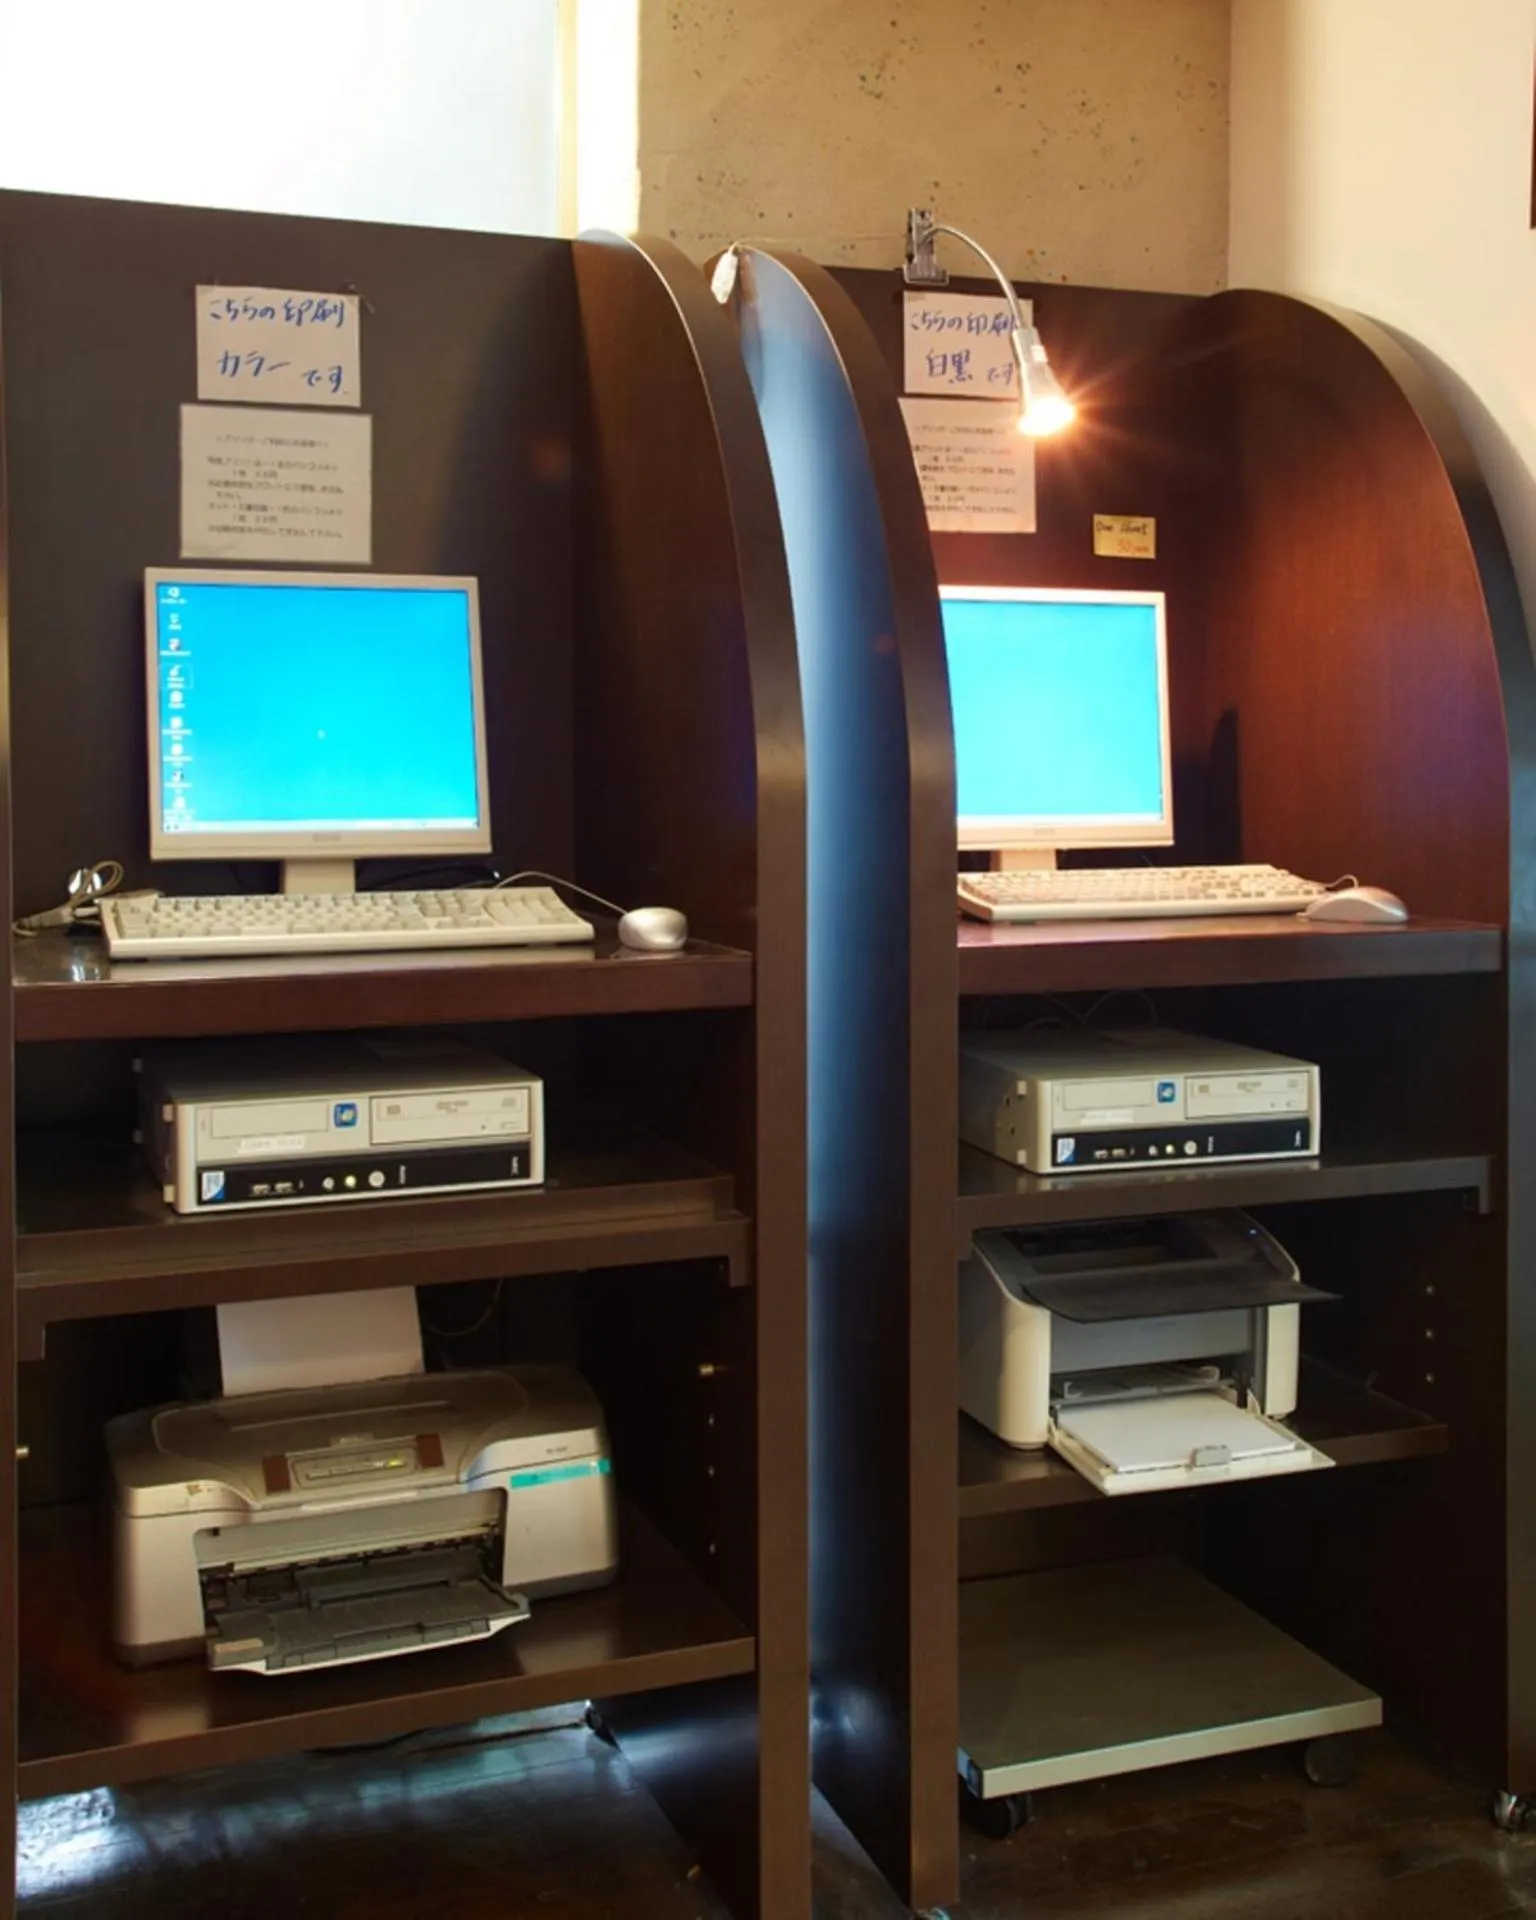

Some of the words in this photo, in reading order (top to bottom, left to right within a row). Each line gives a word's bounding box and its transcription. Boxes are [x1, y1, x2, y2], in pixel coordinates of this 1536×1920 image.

[210, 297, 344, 328] こちらの印刷
